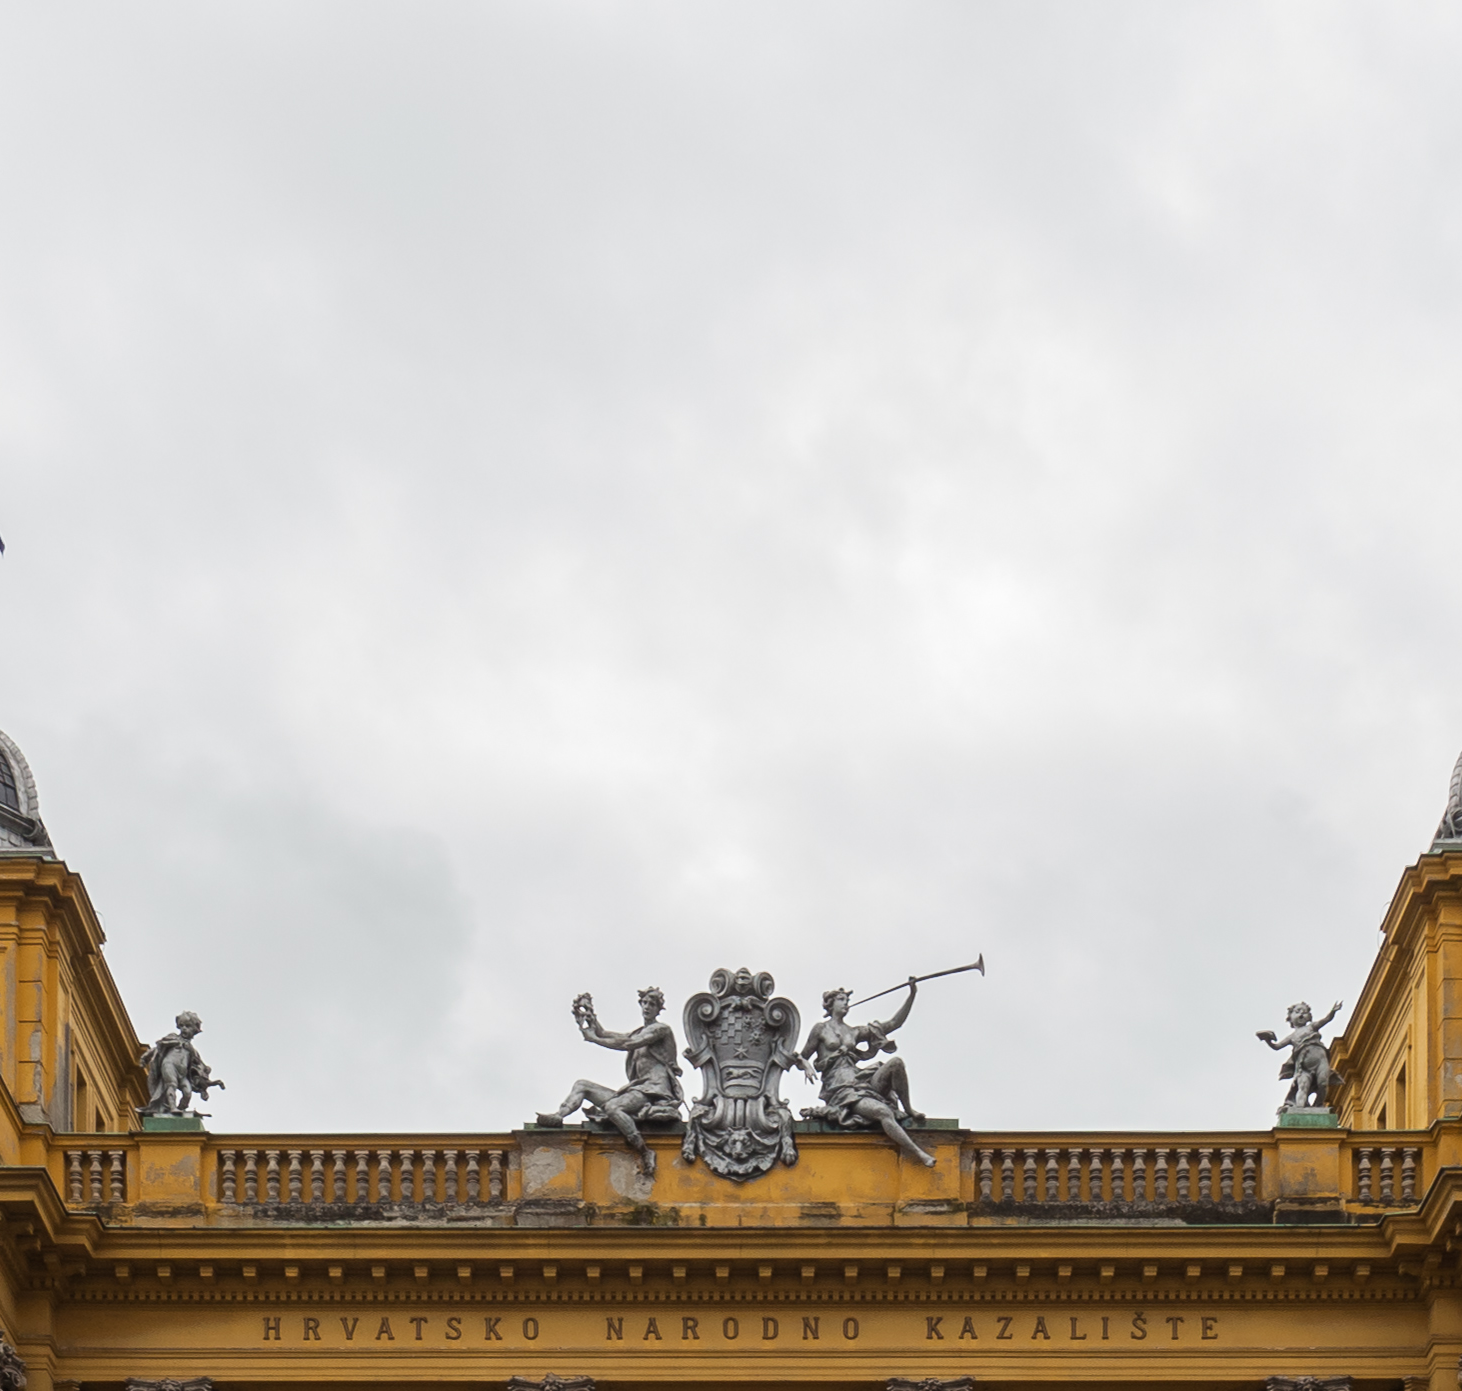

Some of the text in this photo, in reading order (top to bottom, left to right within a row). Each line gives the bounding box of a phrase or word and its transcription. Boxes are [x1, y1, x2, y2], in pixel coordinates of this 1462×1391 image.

[262, 1311, 1219, 1341] HRVATSKO NARODNO KAZALIŠTE
